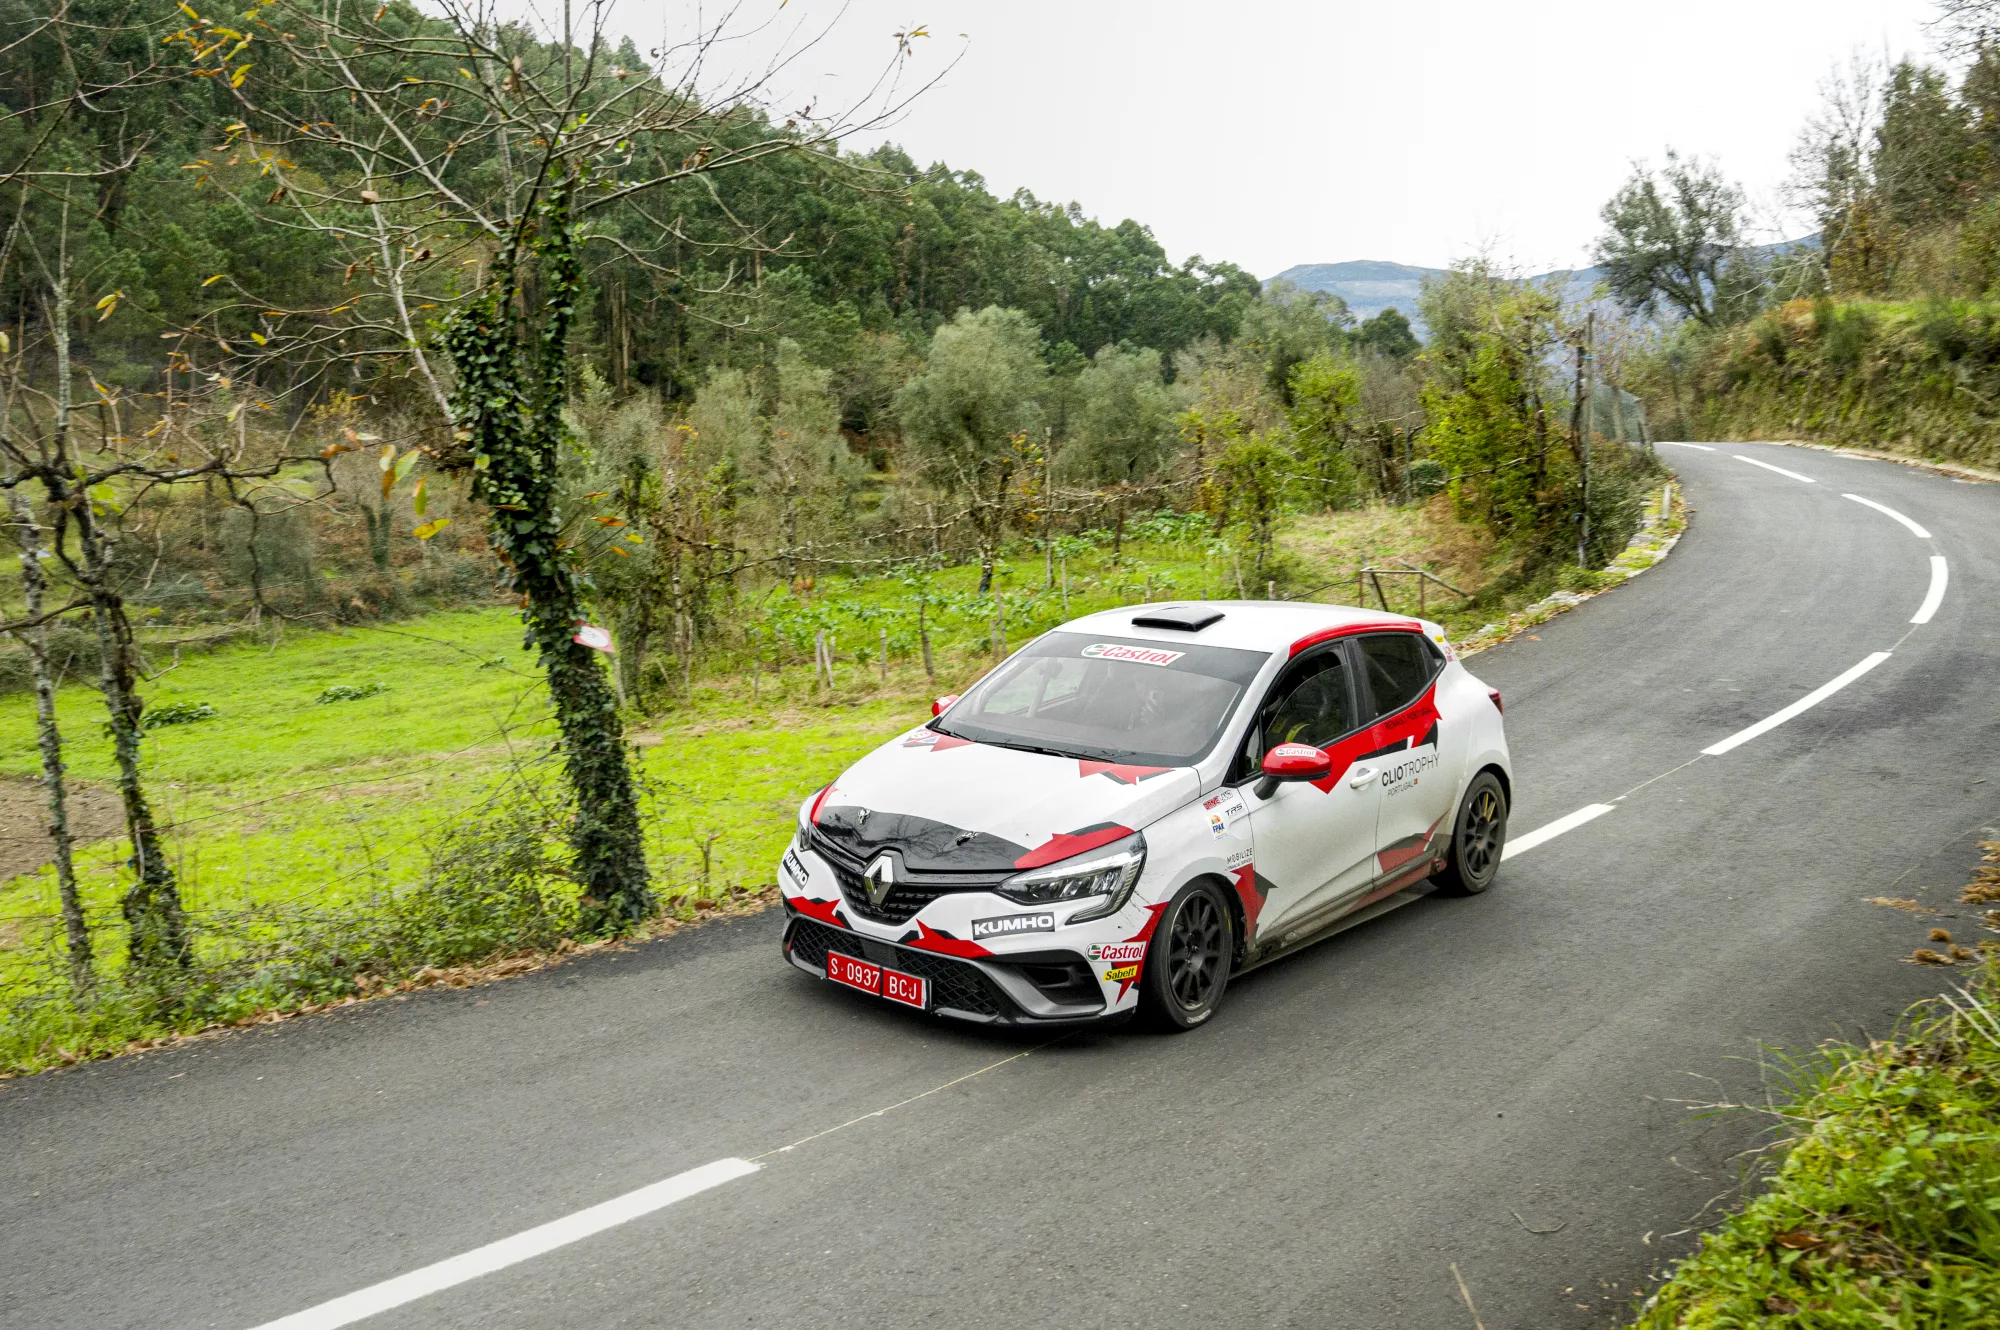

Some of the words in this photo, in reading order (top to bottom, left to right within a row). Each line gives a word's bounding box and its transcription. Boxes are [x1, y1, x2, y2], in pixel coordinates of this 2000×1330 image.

[1102, 646, 1178, 664] Castrol
[1286, 748, 1315, 757] Castrol
[1387, 779, 1414, 798] PORTUGAL
[1225, 803, 1243, 816] TRS
[1212, 822, 1225, 834] FPAK
[1226, 847, 1253, 864] MOBILIZE
[784, 850, 808, 886] KUMHO
[973, 915, 1054, 936] KUMHO
[1101, 944, 1144, 960] Castrol
[830, 957, 839, 975] S
[847, 962, 881, 988] 0937
[889, 975, 917, 1000] BCJ
[1105, 967, 1135, 981] Sabelt
